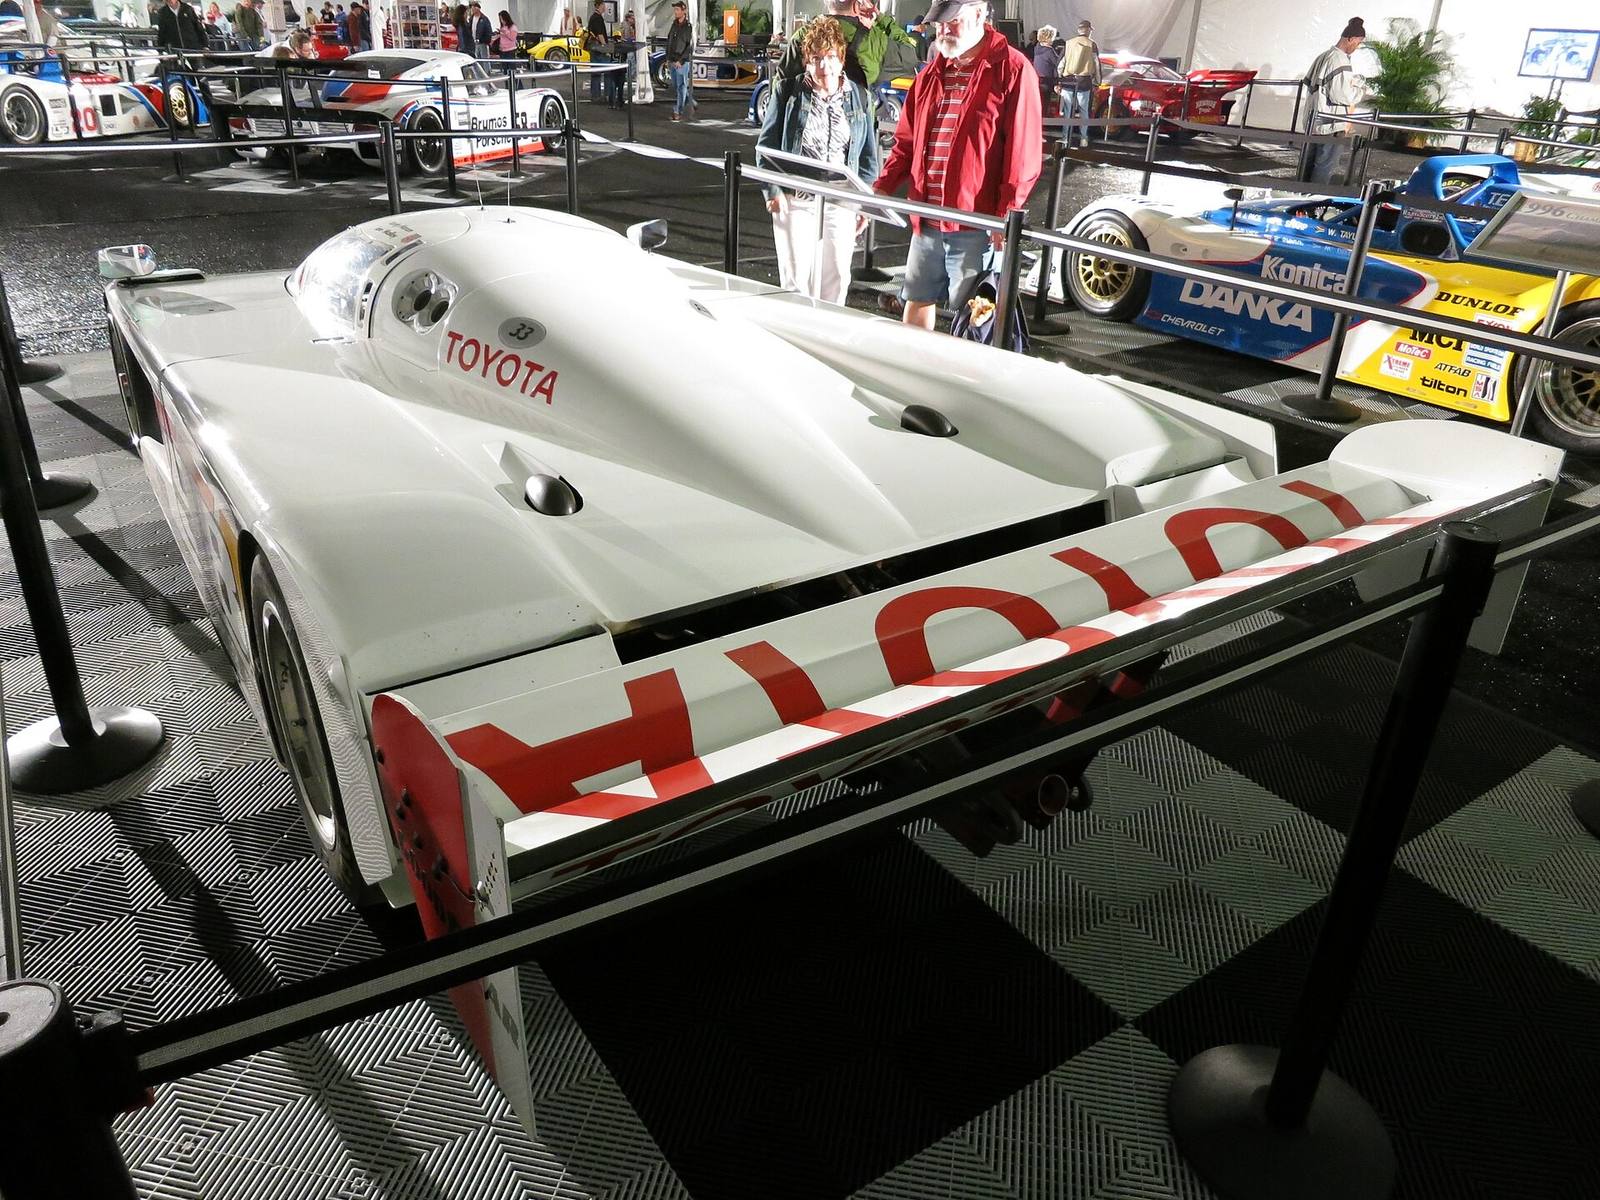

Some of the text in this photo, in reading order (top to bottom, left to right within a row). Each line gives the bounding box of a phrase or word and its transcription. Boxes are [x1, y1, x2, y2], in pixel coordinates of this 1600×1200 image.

[471, 116, 508, 131] Brumos
[1260, 254, 1347, 294] Konica
[1178, 278, 1313, 333] DANKA
[508, 322, 535, 341] 33
[1161, 314, 1225, 336] CHEVROLET
[446, 330, 560, 405] TOYOTA
[1420, 376, 1468, 398] tilton
